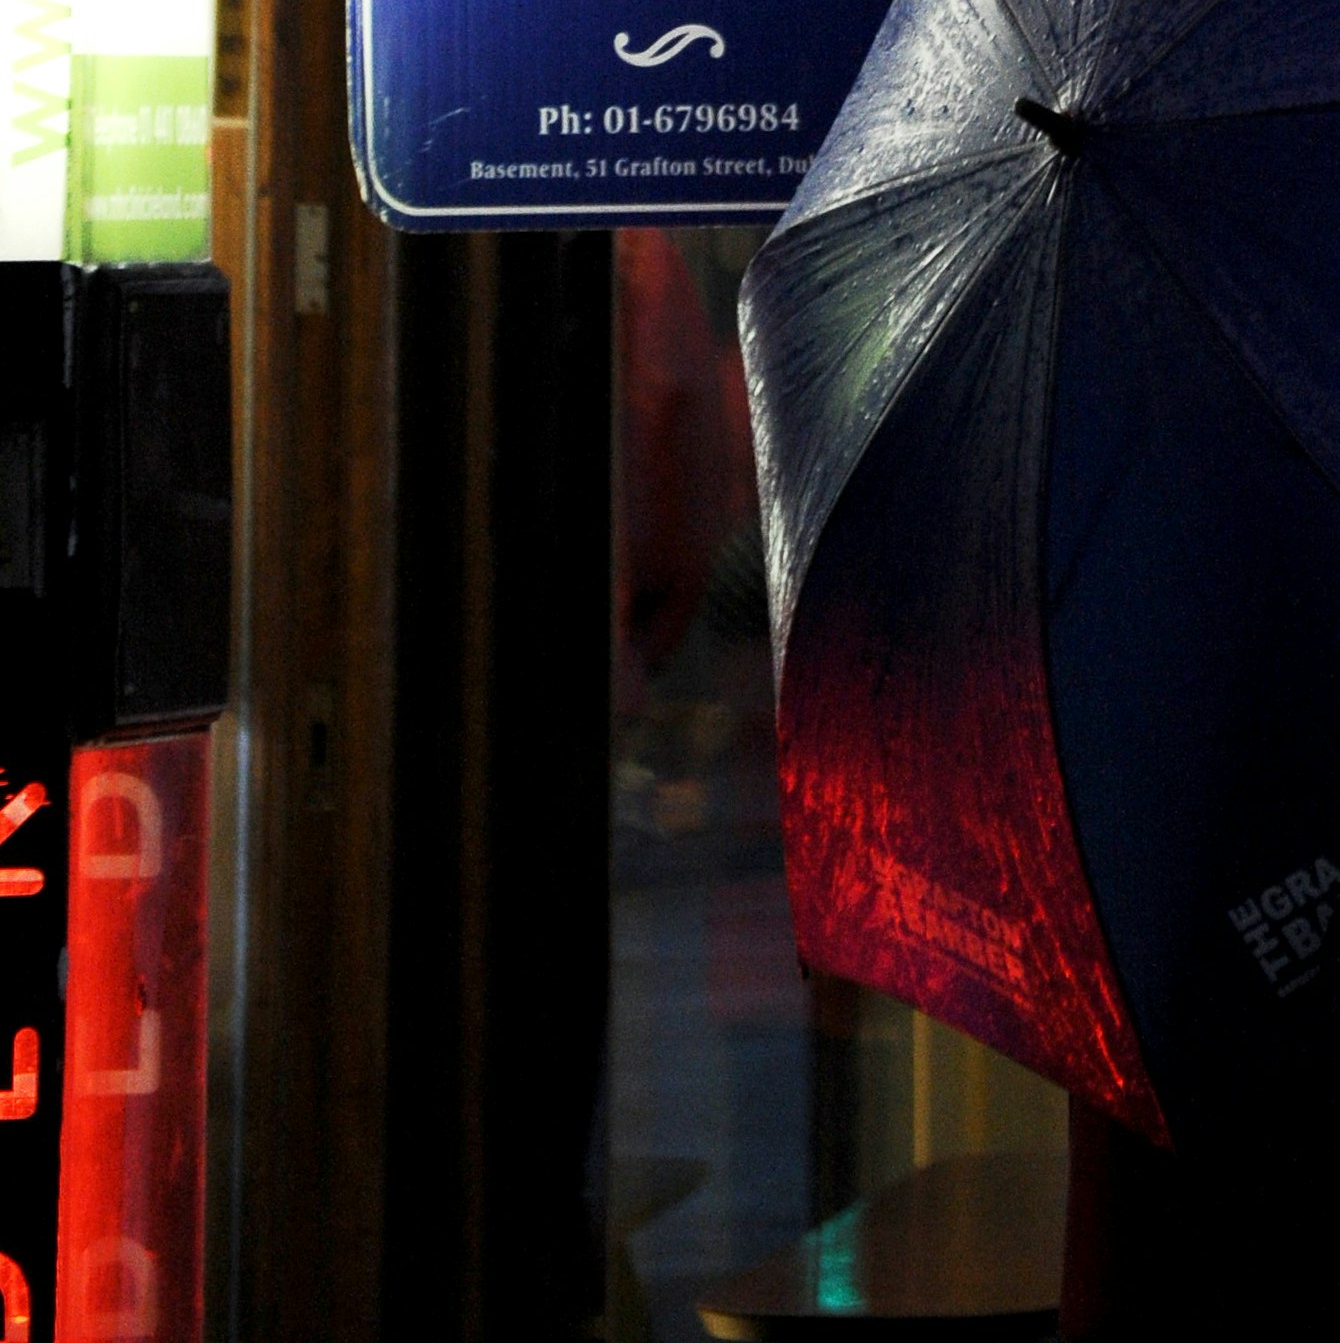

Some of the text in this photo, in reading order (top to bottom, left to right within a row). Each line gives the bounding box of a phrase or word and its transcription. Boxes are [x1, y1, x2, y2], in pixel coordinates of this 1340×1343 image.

[538, 102, 800, 136] Ph: 01-6796984
[470, 159, 582, 181] Basement,
[585, 157, 609, 178] 51
[614, 157, 697, 179] Grafton
[702, 156, 774, 180] Street,
[1227, 896, 1292, 984] THE
